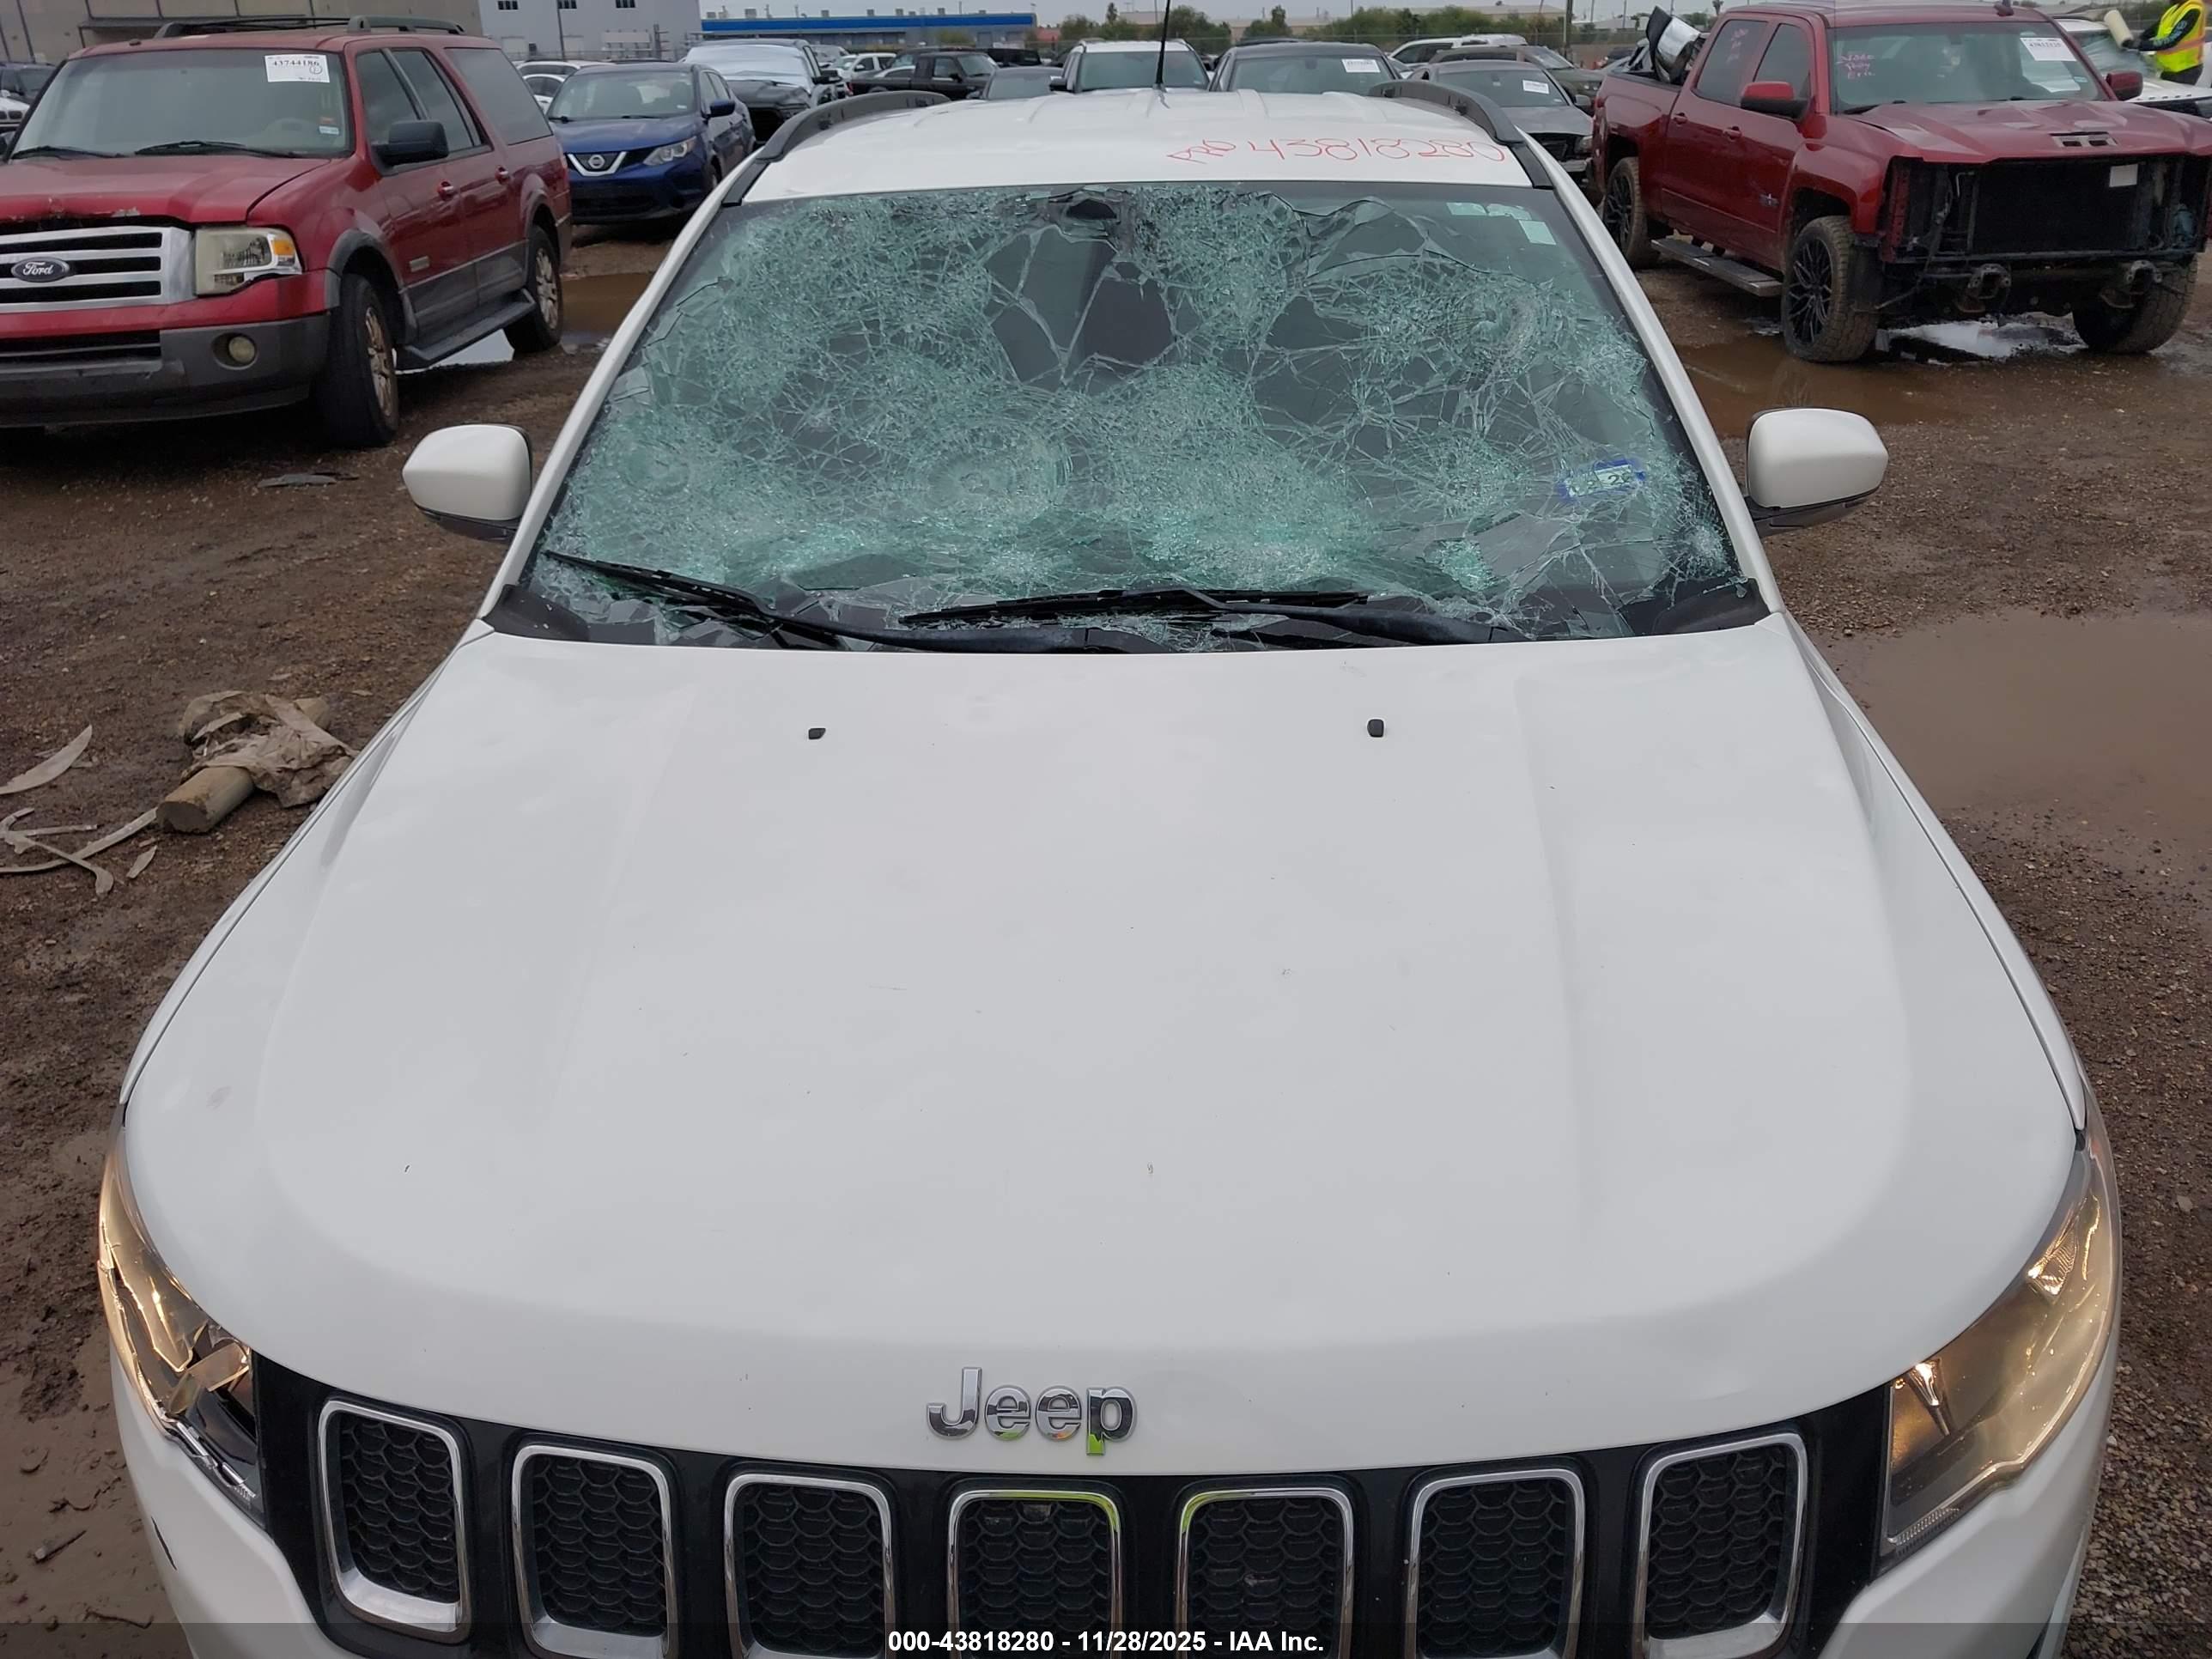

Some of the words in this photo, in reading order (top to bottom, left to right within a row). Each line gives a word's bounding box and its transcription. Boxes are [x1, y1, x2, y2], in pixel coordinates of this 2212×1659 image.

[1247, 137, 1506, 162] 43818280
[22, 261, 54, 276] Ford
[926, 1366, 1138, 1456] Jeep
